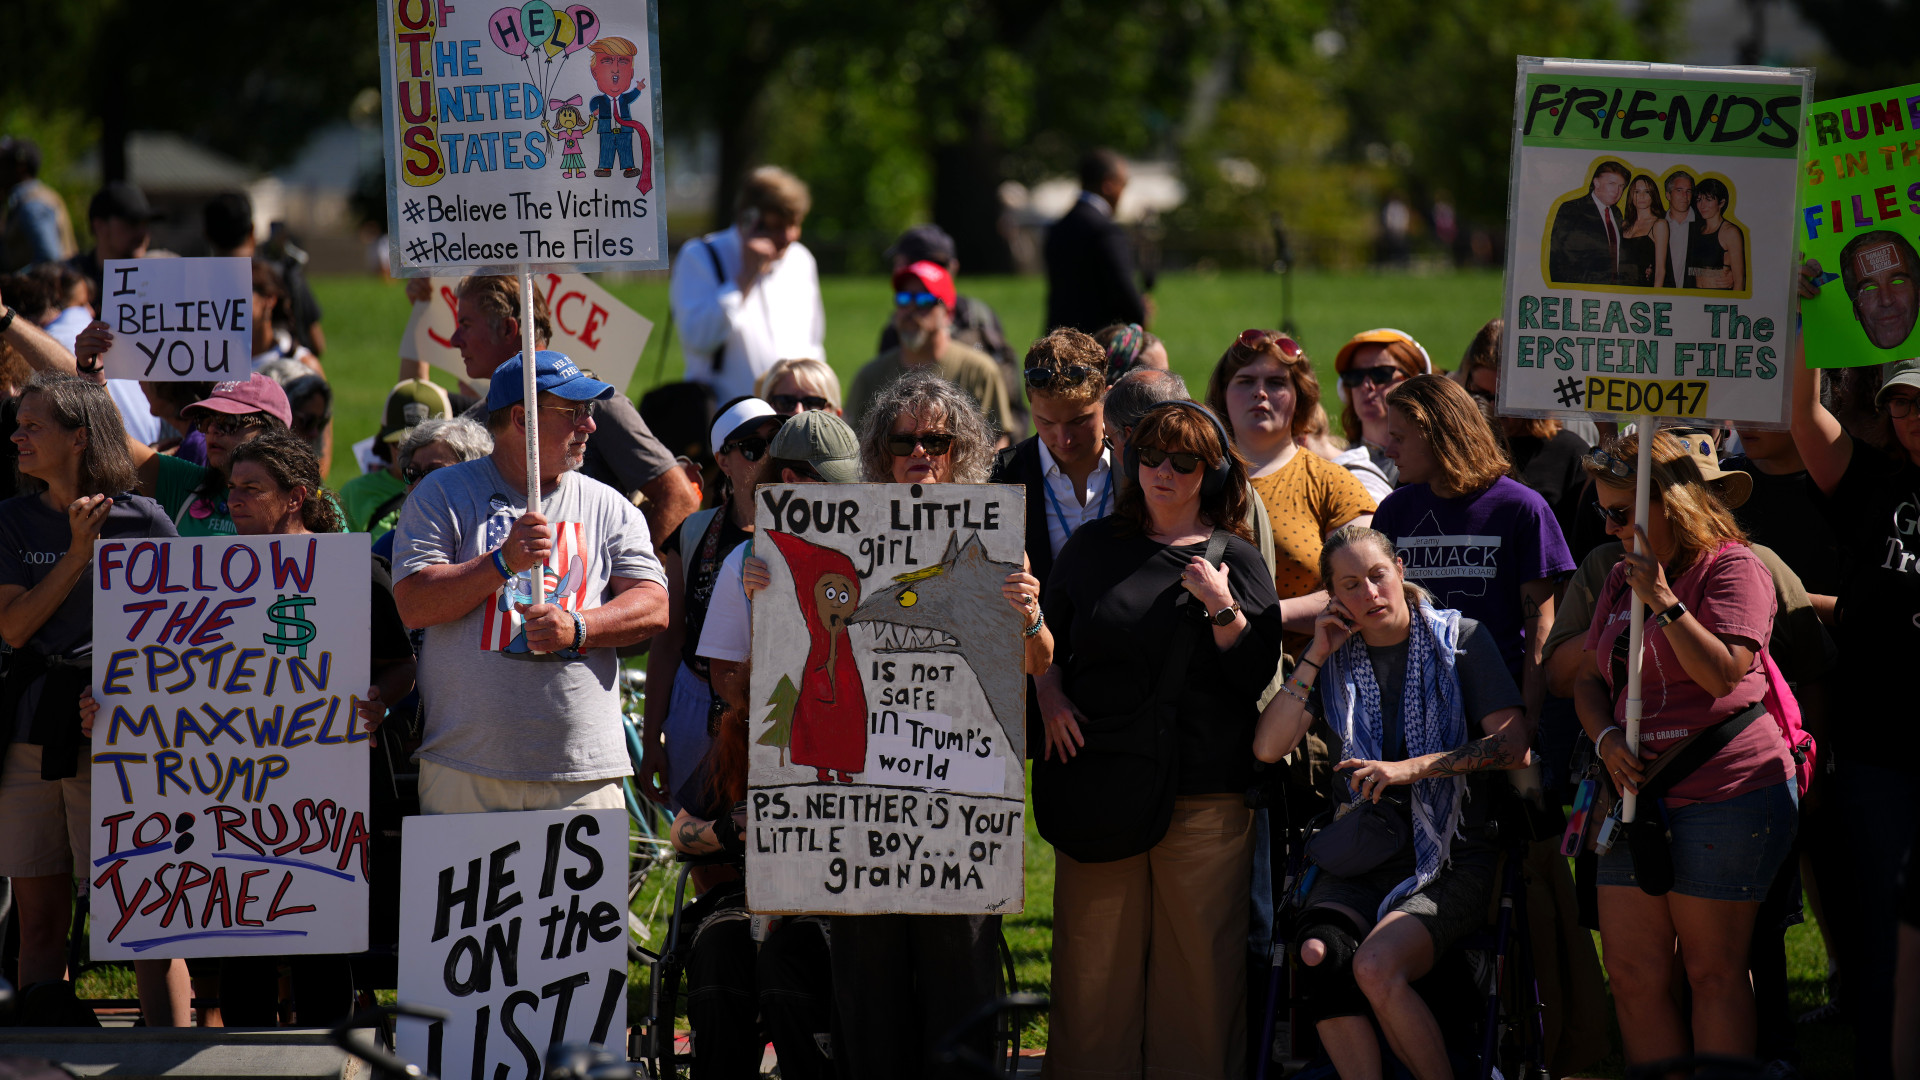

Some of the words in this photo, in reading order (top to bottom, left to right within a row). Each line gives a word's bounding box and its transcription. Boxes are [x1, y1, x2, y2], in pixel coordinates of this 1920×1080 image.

[494, 9, 596, 49] HELP
[1805, 159, 1825, 186] S
[1833, 150, 1870, 180] IN
[1878, 139, 1920, 171] TH
[402, 194, 507, 224] #Believe
[509, 191, 552, 220] The
[557, 189, 648, 220] Victims
[1803, 182, 1920, 241] FILES
[405, 232, 519, 263] #Release
[520, 230, 565, 258] The
[573, 228, 634, 259] Files
[113, 267, 139, 296] I
[117, 298, 247, 335] BELIEVE
[1518, 295, 1673, 337] RELEASE
[1703, 304, 1775, 343] The
[136, 338, 230, 377] YOU
[552, 358, 567, 371] HE
[1517, 335, 1659, 374] EPSTEIN
[1674, 342, 1778, 380] FILES
[207, 518, 238, 533] FEMIN
[761, 489, 861, 535] YOUR
[19, 549, 56, 565] OOD
[98, 537, 318, 594] FOLLOW
[1407, 568, 1434, 578] INGTON
[1435, 567, 1466, 576] COUNTY
[1468, 567, 1497, 576] BOARD
[123, 596, 256, 647] THE
[102, 641, 333, 697] EPSTEIN
[872, 661, 896, 683] IS
[105, 694, 370, 749] MAXWELL
[1640, 732, 1655, 743] EING
[1656, 728, 1689, 740] GRABBED
[91, 749, 291, 804] TRUMP
[879, 753, 950, 781] world
[753, 792, 799, 822] P.S.
[806, 792, 919, 827] NEITHER
[203, 798, 370, 885] RUSSIA
[431, 840, 524, 943] HE
[538, 813, 605, 900] IS
[443, 916, 523, 998] ON
[539, 894, 623, 960] the
